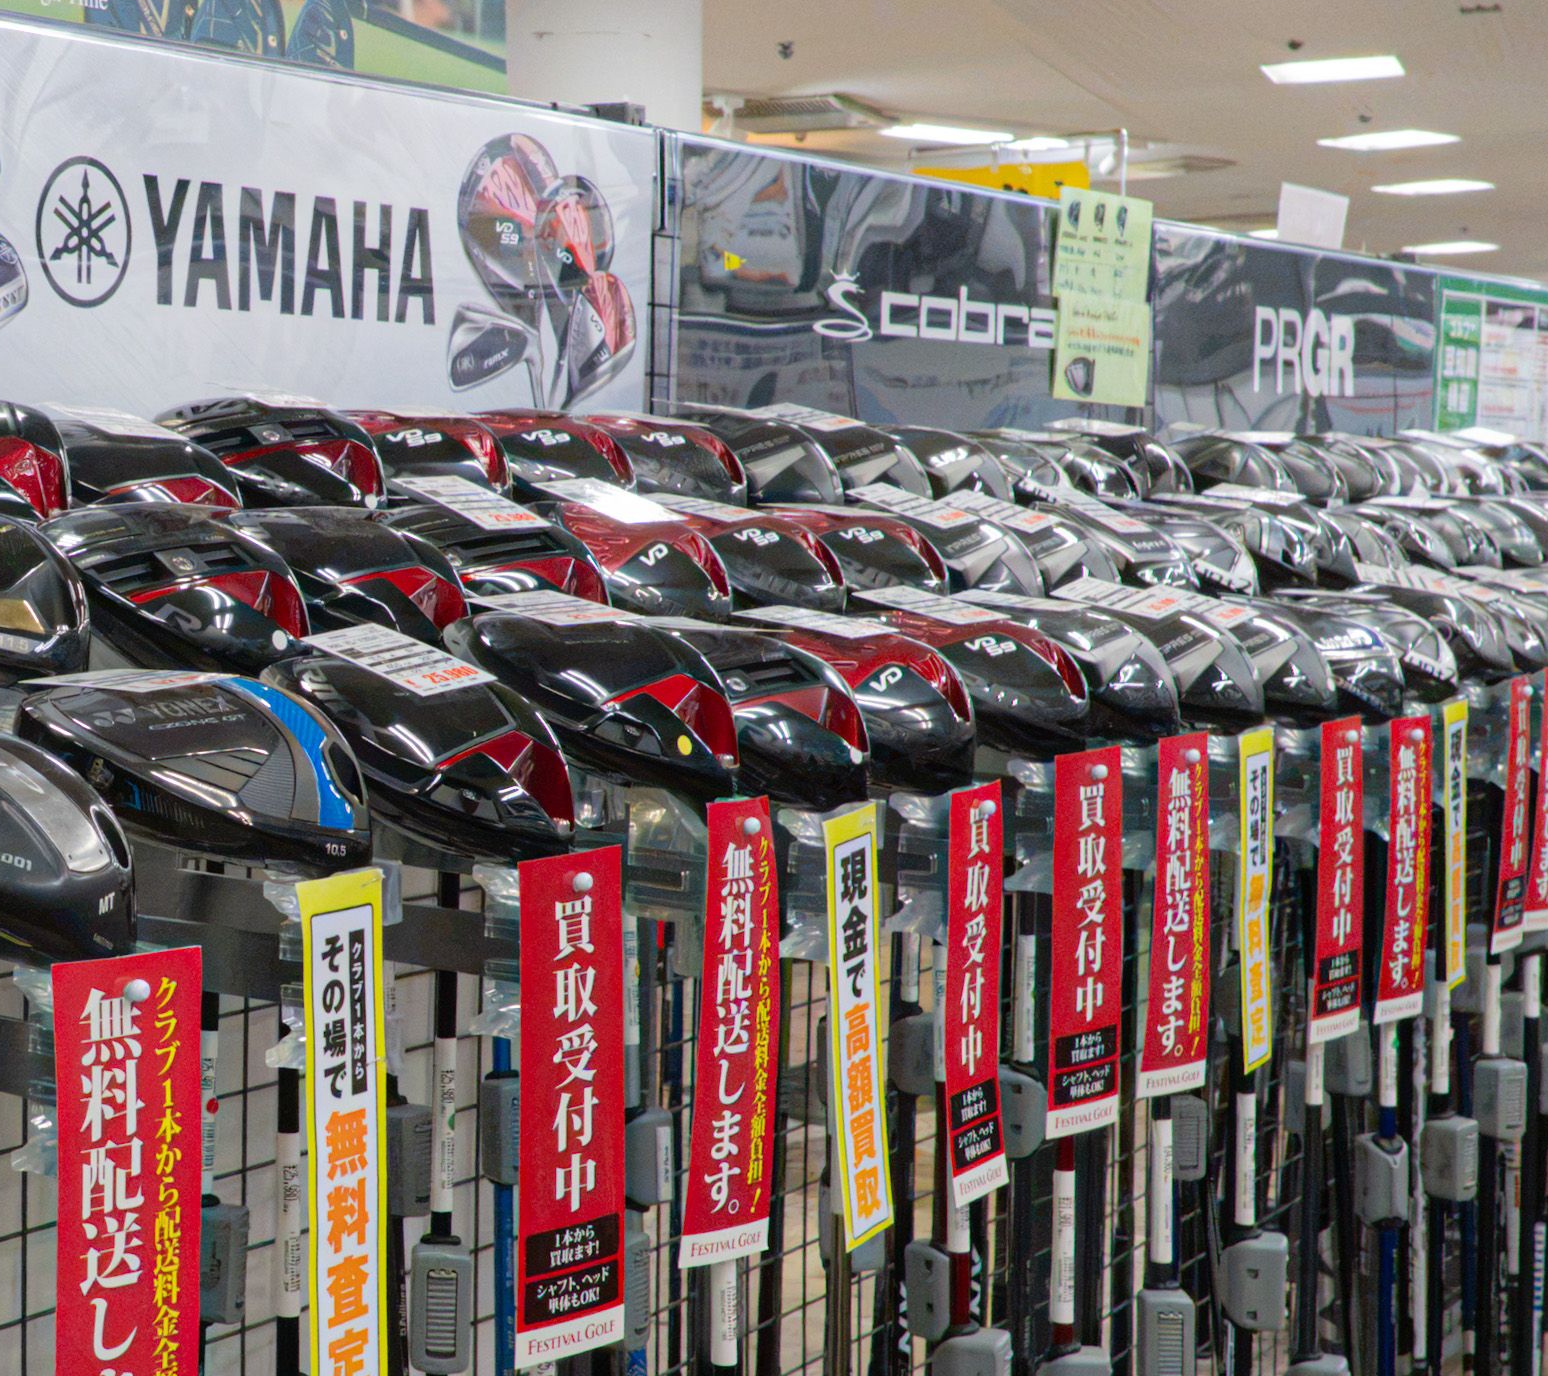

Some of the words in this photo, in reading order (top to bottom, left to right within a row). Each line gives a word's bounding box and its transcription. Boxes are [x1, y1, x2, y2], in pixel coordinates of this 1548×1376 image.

[141, 173, 438, 327] YAMAHA
[881, 286, 1055, 348] cobra
[1253, 305, 1356, 398] PRGR
[0, 852, 33, 872] 001
[98, 893, 116, 915] MT
[1074, 782, 1107, 1023] 買取受付中
[551, 895, 599, 1212] 買取受付中
[704, 842, 755, 1216] 無料配送します。
[526, 1327, 581, 1355] FESTIVAL
[584, 1319, 615, 1340] GOLF
